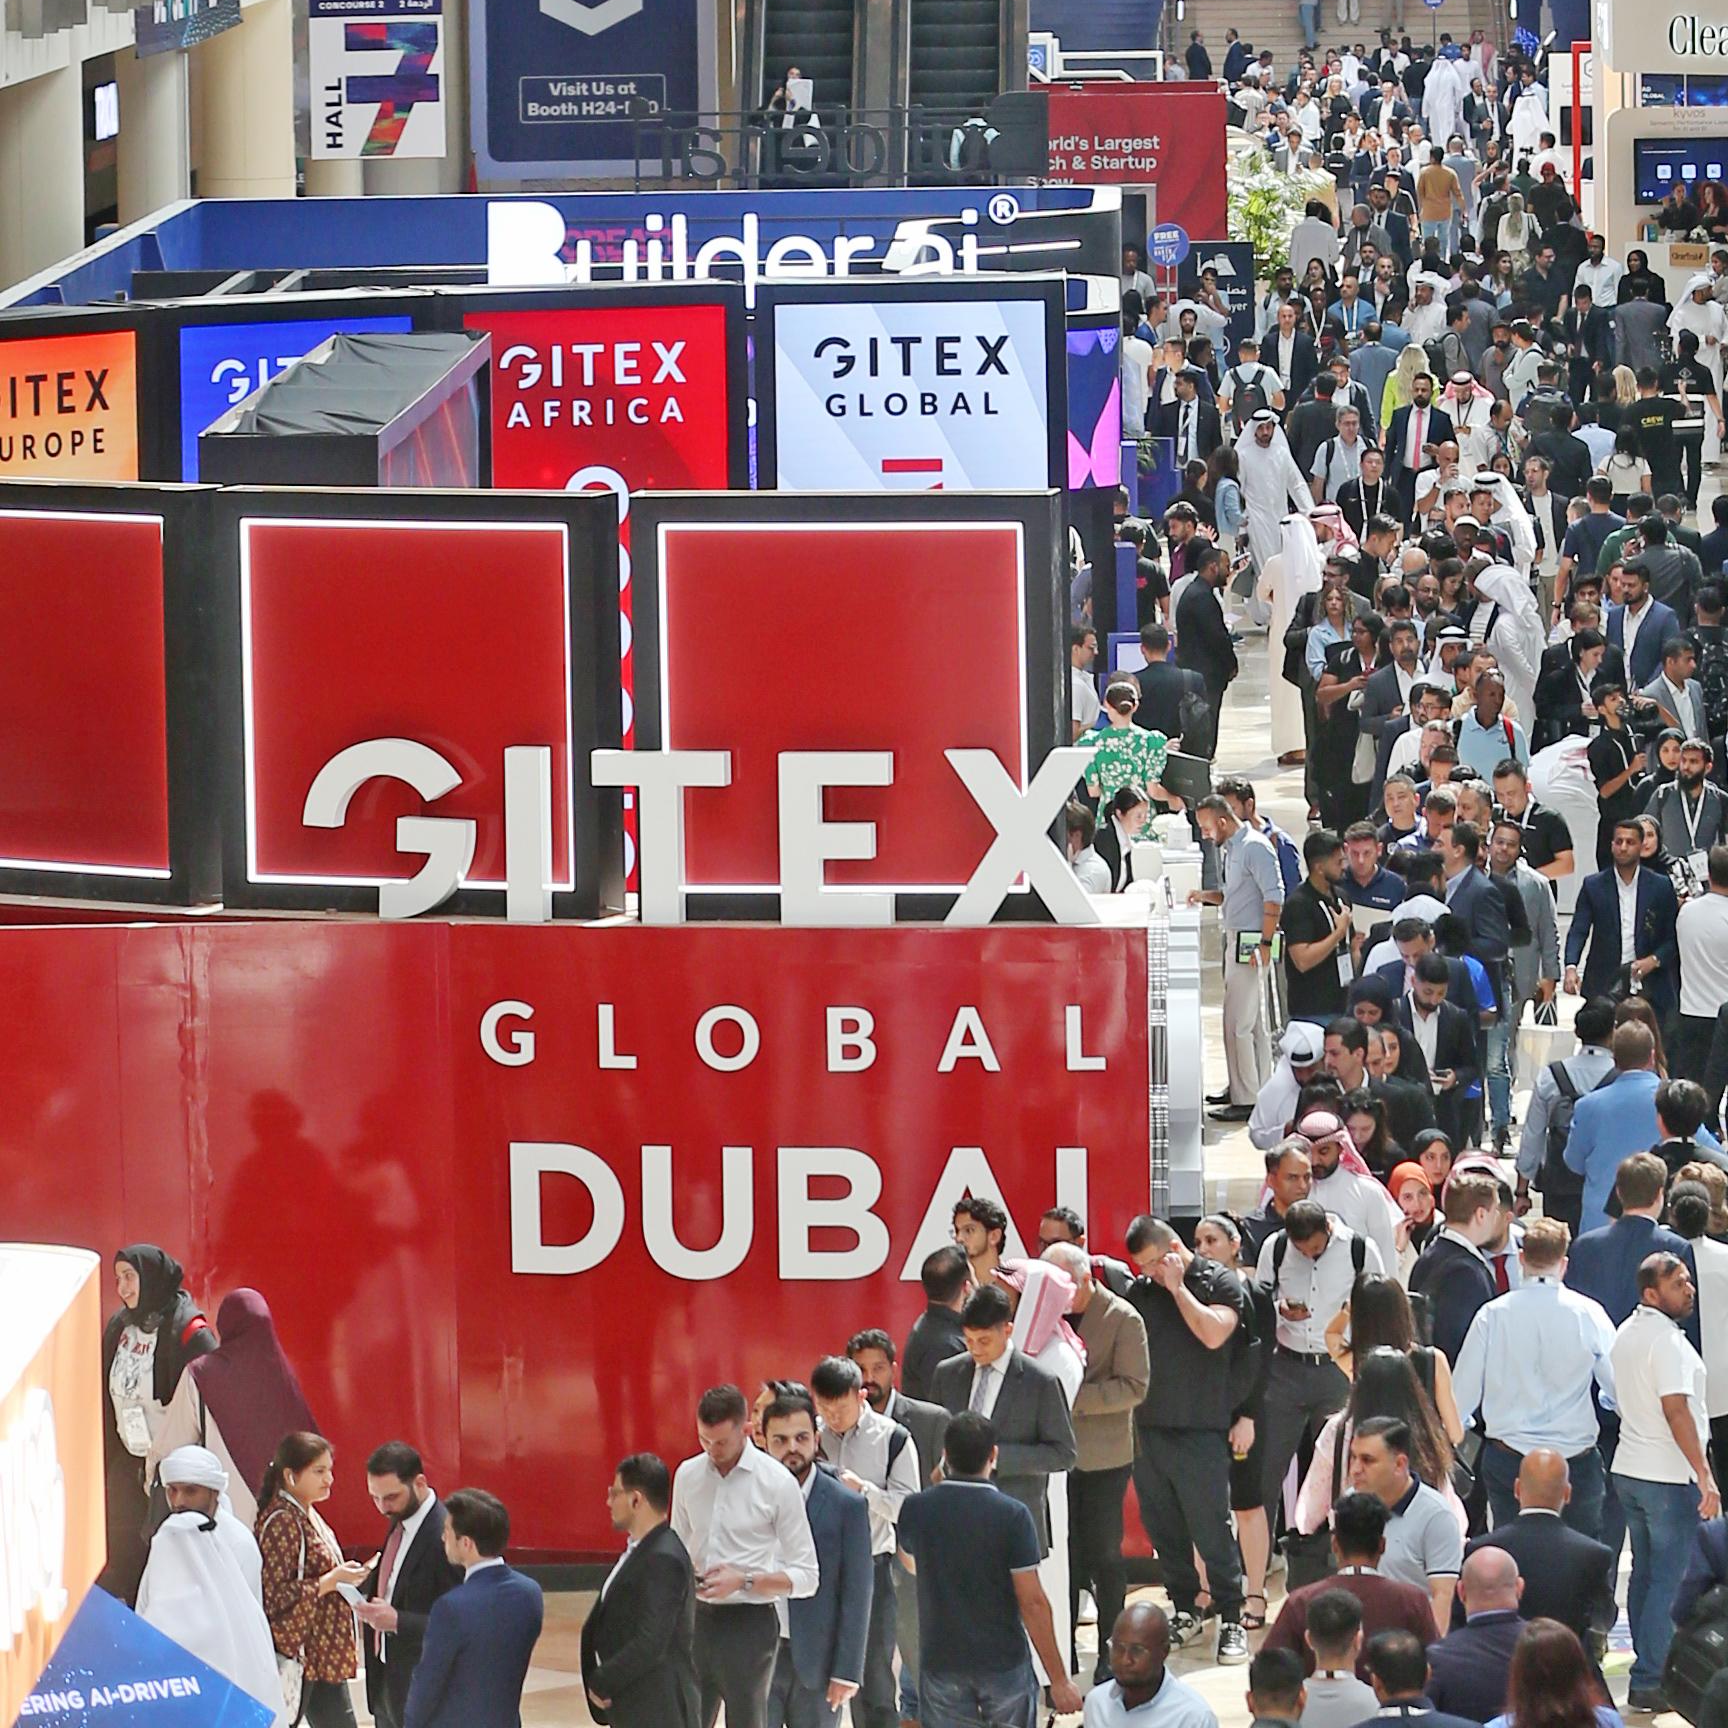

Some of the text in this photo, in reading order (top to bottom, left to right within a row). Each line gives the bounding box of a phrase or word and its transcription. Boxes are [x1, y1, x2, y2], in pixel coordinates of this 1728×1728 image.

[317, 0, 376, 11] CONCOURSE
[344, 21, 440, 156] 7
[549, 81, 638, 97] Visit Us at
[324, 76, 344, 150] HALL
[527, 101, 579, 117] Booth
[1094, 135, 1161, 153] Largest
[1072, 155, 1158, 172] & Startup
[499, 341, 688, 391] GITEX
[813, 334, 1010, 380] GITEX
[507, 396, 686, 431] AFRICA
[824, 391, 1001, 419] GLOBAL
[301, 738, 1104, 927] GITEX
[479, 999, 1108, 1073] GLOBAL
[509, 1140, 1090, 1282] DUBAI
[90, 1675, 202, 1709] AI-DRIVEN
